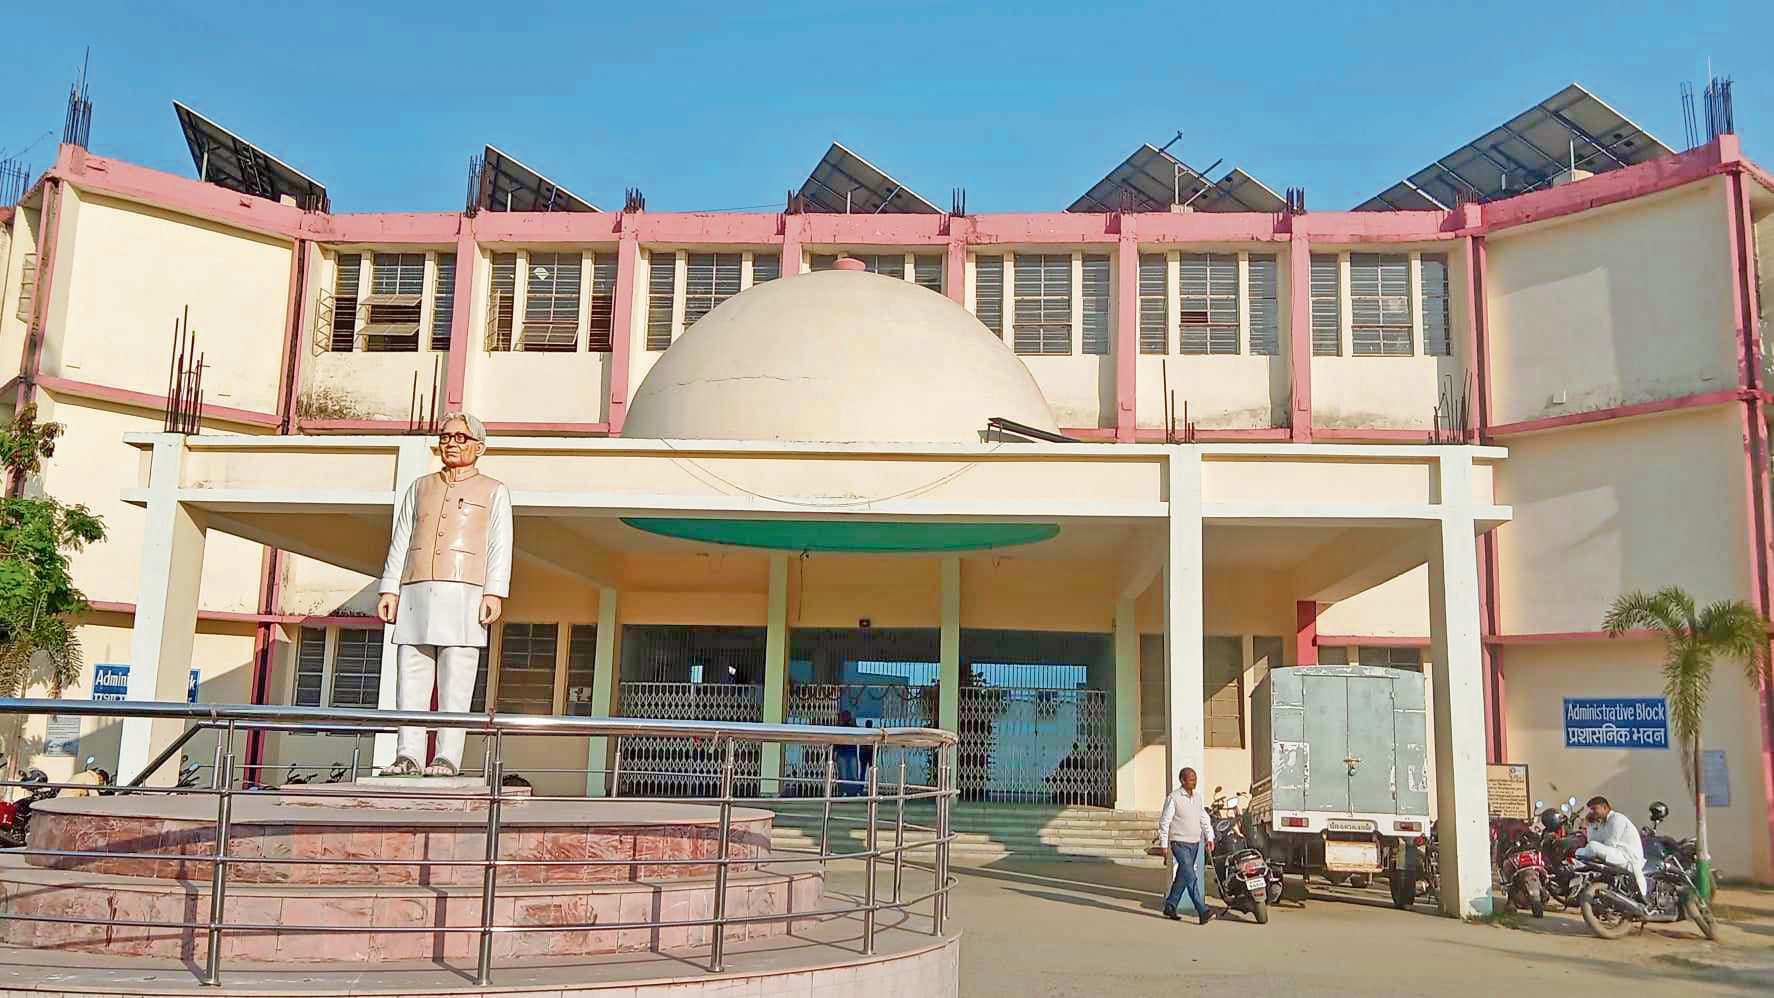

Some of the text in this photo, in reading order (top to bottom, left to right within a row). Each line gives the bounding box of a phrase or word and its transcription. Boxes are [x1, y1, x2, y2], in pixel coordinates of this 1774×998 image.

[1567, 703, 1665, 721] Administrative Block
[1567, 723, 1665, 745] प्रशासनिक भवन
